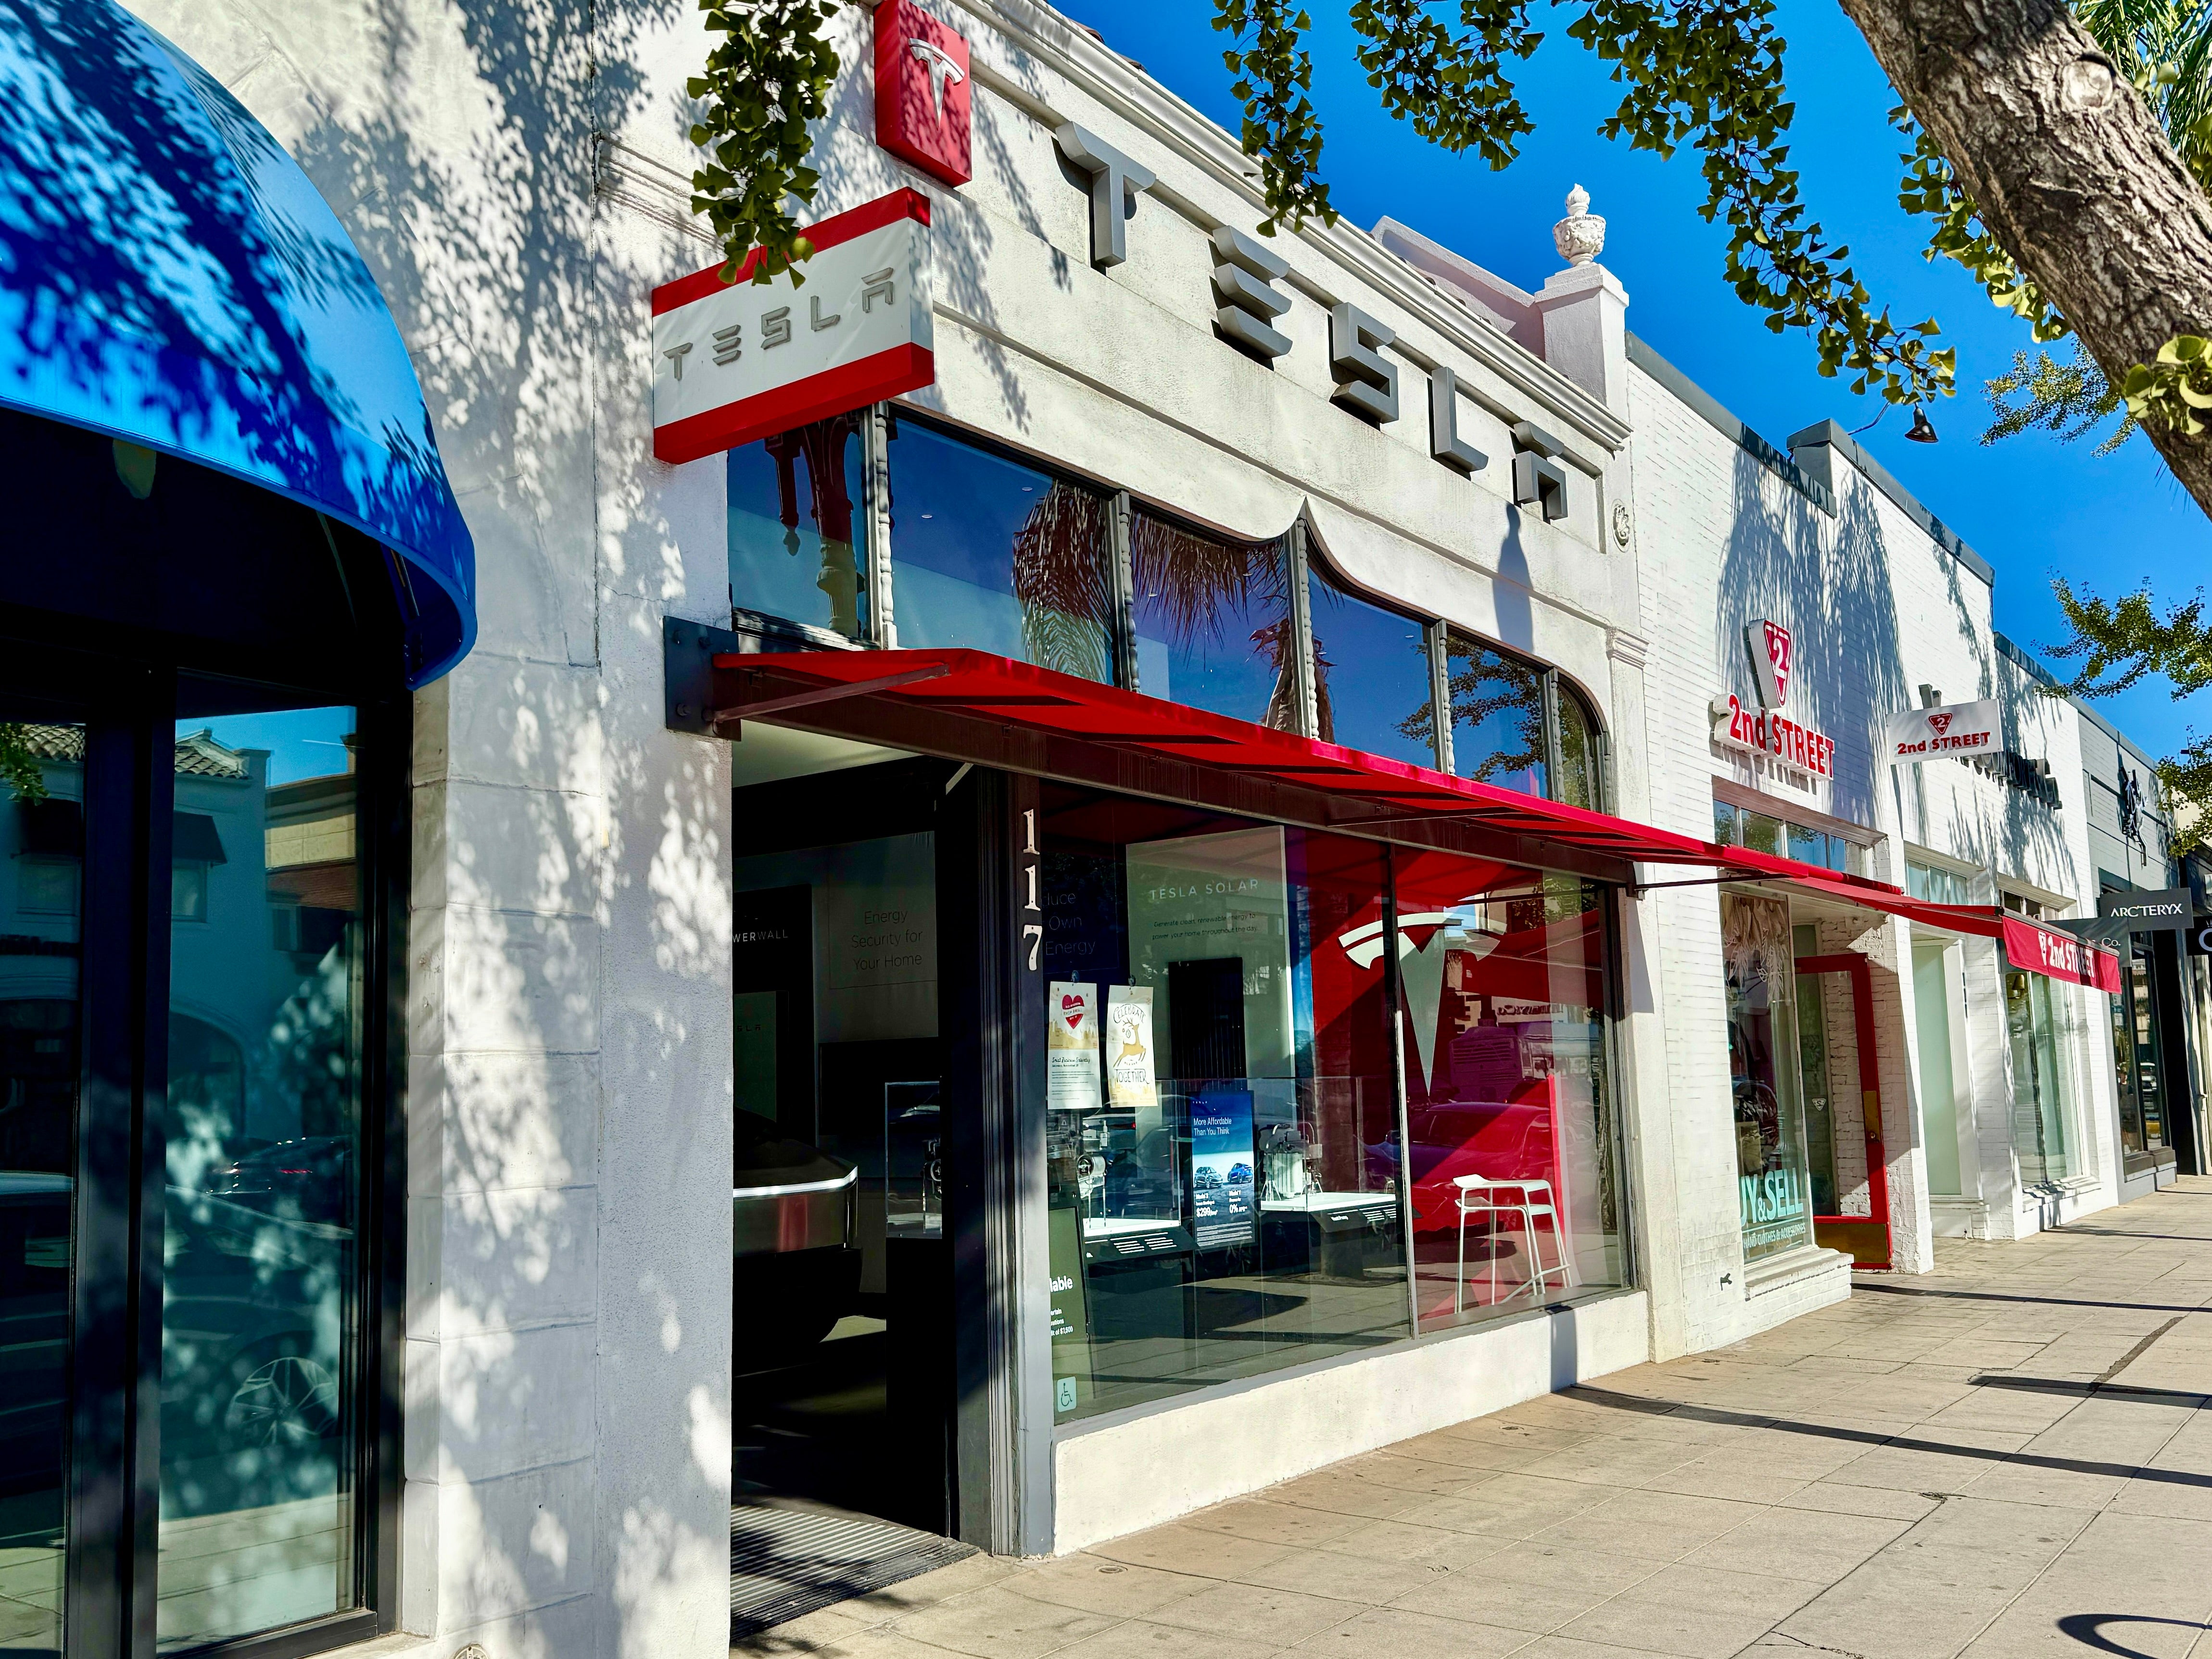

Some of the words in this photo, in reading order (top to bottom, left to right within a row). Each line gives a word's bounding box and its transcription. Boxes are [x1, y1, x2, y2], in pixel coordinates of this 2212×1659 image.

[663, 266, 894, 381] TESLA
[1054, 120, 1568, 520] TESLA
[1728, 693, 1767, 751] 2nd
[1771, 714, 1835, 780] STREET
[1897, 740, 1926, 755] 2nd
[1932, 732, 1990, 750] STREET
[1150, 886, 1197, 900] TESLA
[1206, 879, 1258, 894] SOLAR
[864, 910, 908, 924] Energy
[1198, 915, 1226, 923] renewable
[2110, 902, 2184, 918] ARC'TERYX
[1049, 916, 1082, 930] Own
[851, 934, 901, 948] Security
[905, 929, 923, 943] for
[2101, 937, 2121, 947] Co.
[1045, 941, 1096, 955] Energy
[2048, 935, 2066, 970] 2nd
[853, 956, 879, 971] Your
[885, 953, 922, 968] Home
[1193, 1117, 1206, 1126] More
[1207, 1117, 1232, 1126] Affordable
[1193, 1128, 1206, 1136] Than
[1216, 1127, 1229, 1135] Think
[1744, 1235, 1757, 1249] HAND
[1757, 1229, 1776, 1246] CLOTHES
[1776, 1229, 1781, 1240] &
